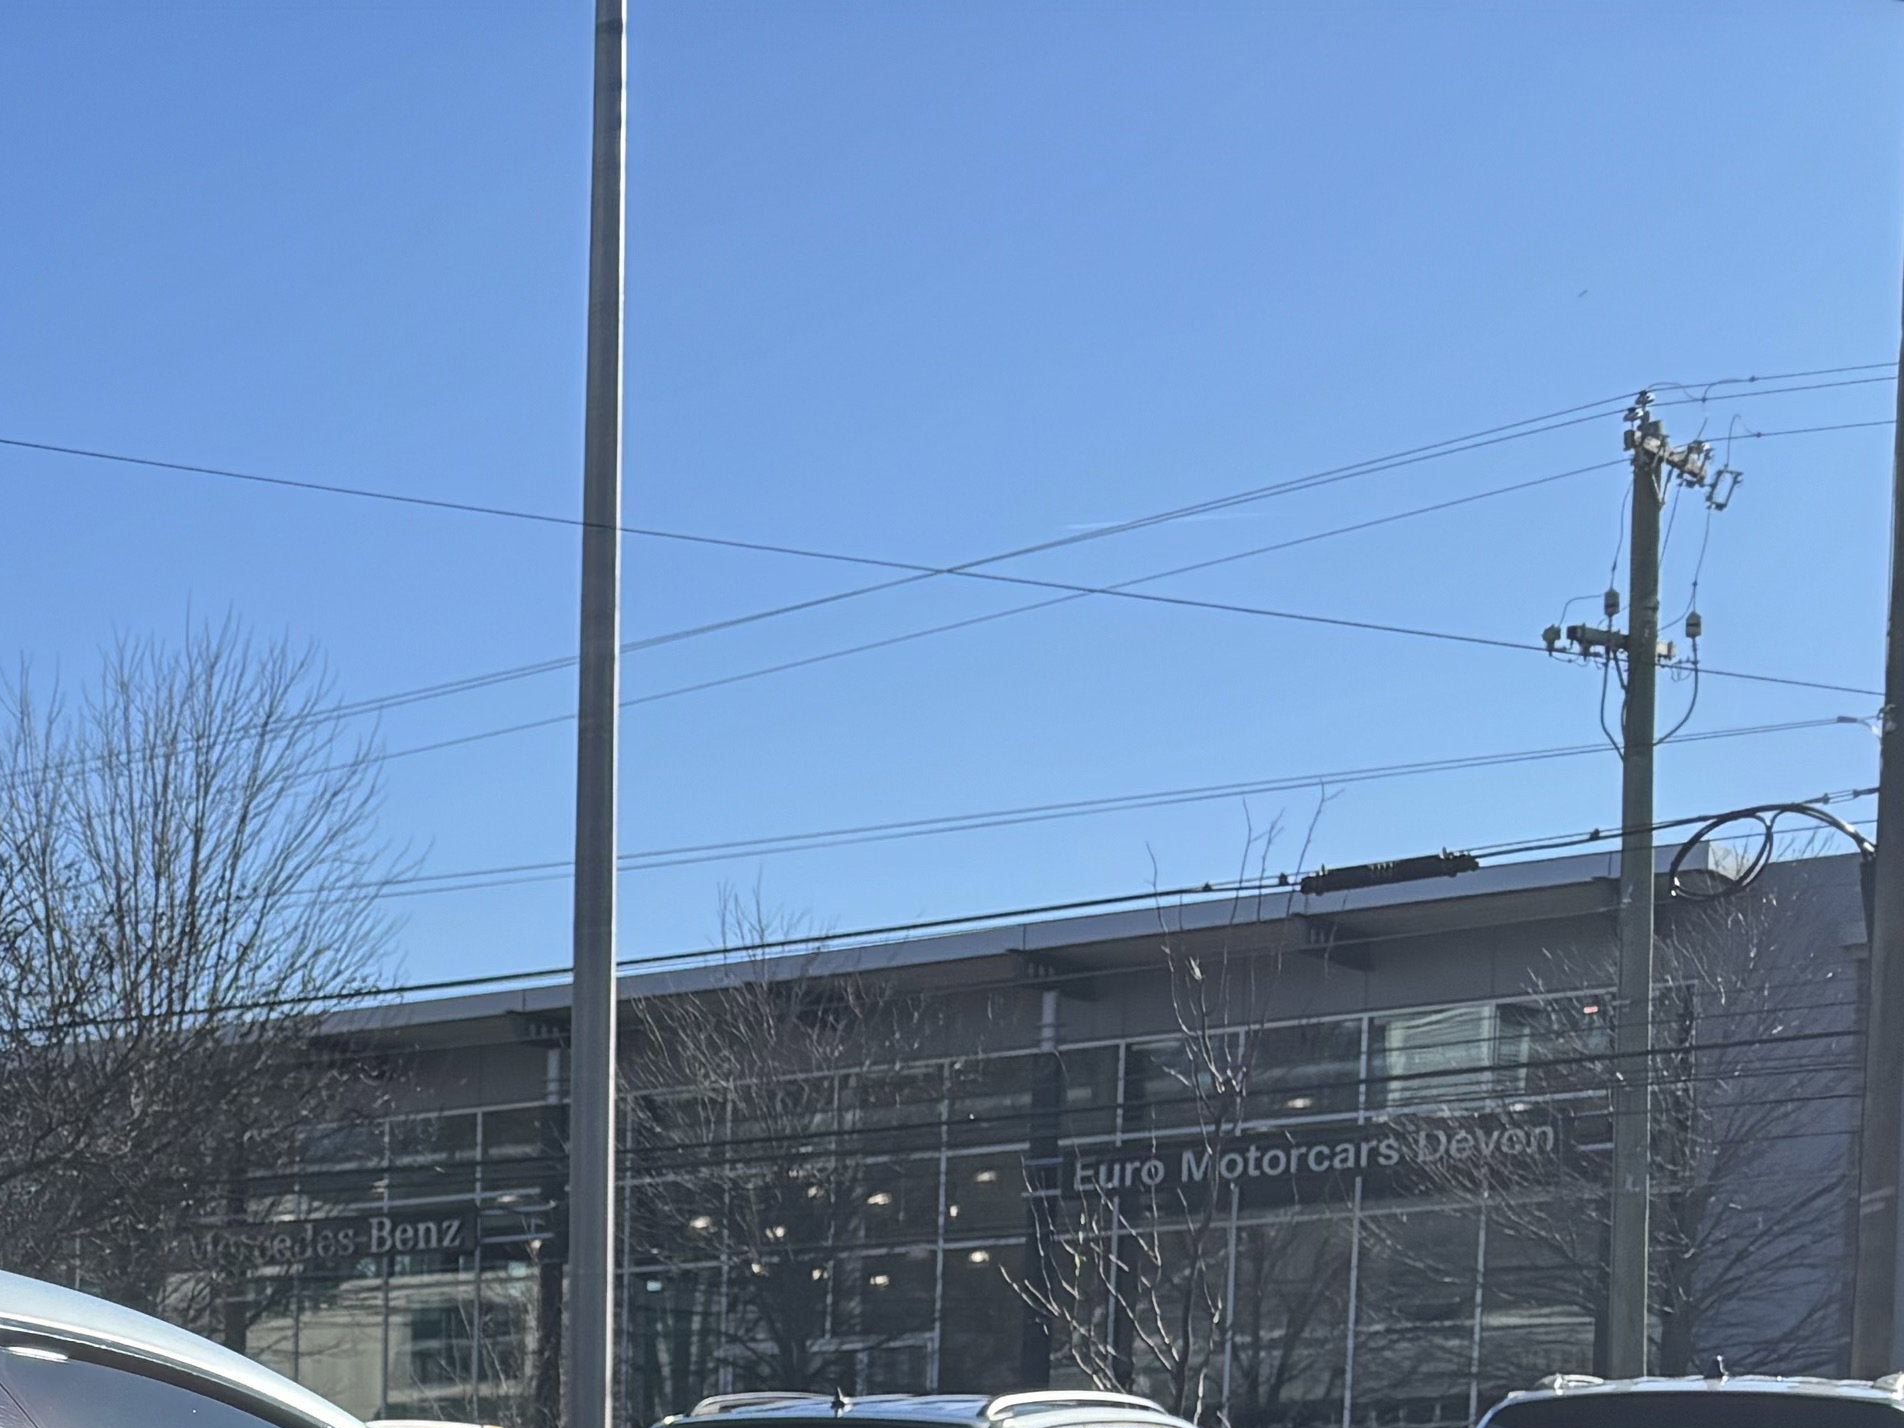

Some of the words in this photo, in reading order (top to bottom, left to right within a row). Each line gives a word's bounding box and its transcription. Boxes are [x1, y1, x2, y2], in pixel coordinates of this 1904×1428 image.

[1073, 1155, 1165, 1192] Euro
[1180, 1130, 1401, 1184] Motorcars
[1417, 1125, 1555, 1163] Devon
